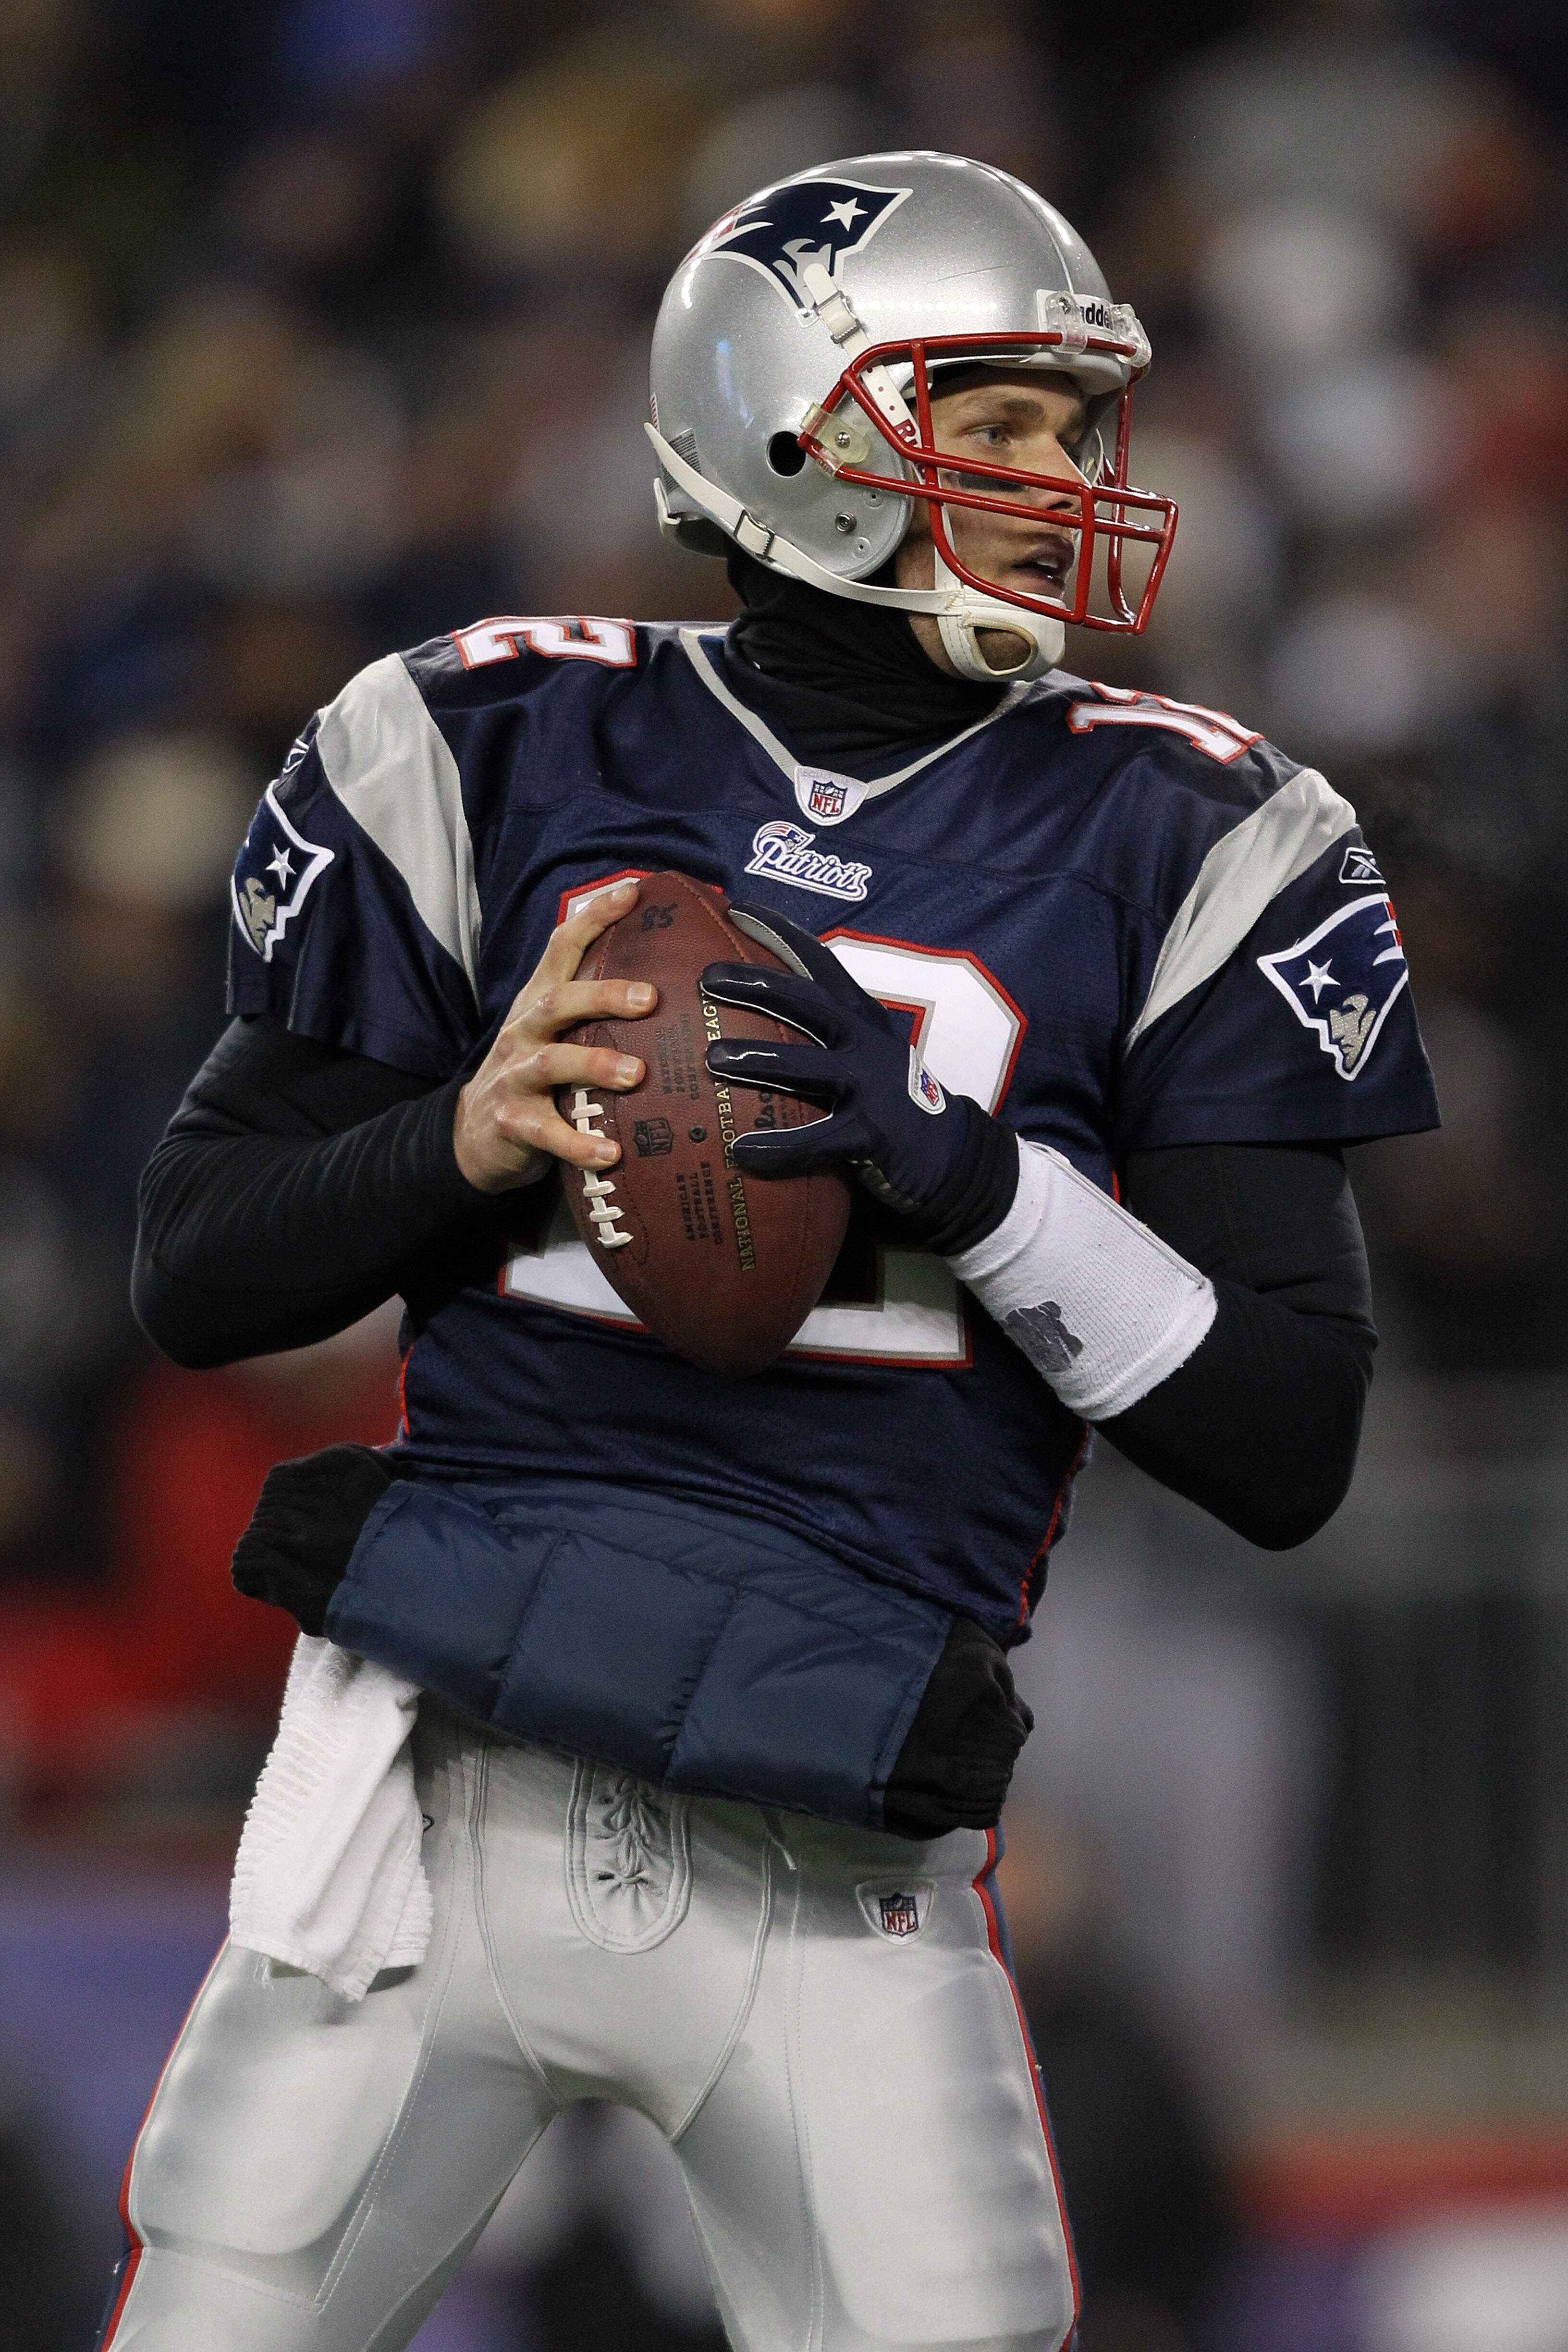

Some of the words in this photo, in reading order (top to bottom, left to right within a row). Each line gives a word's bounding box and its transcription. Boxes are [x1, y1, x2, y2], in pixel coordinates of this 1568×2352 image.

[811, 793, 841, 814] NFL
[752, 836, 870, 890] Patriots
[648, 1121, 671, 1155] NFL
[728, 1176, 756, 1272] NATIONAL
[884, 1911, 915, 1933] NFL
